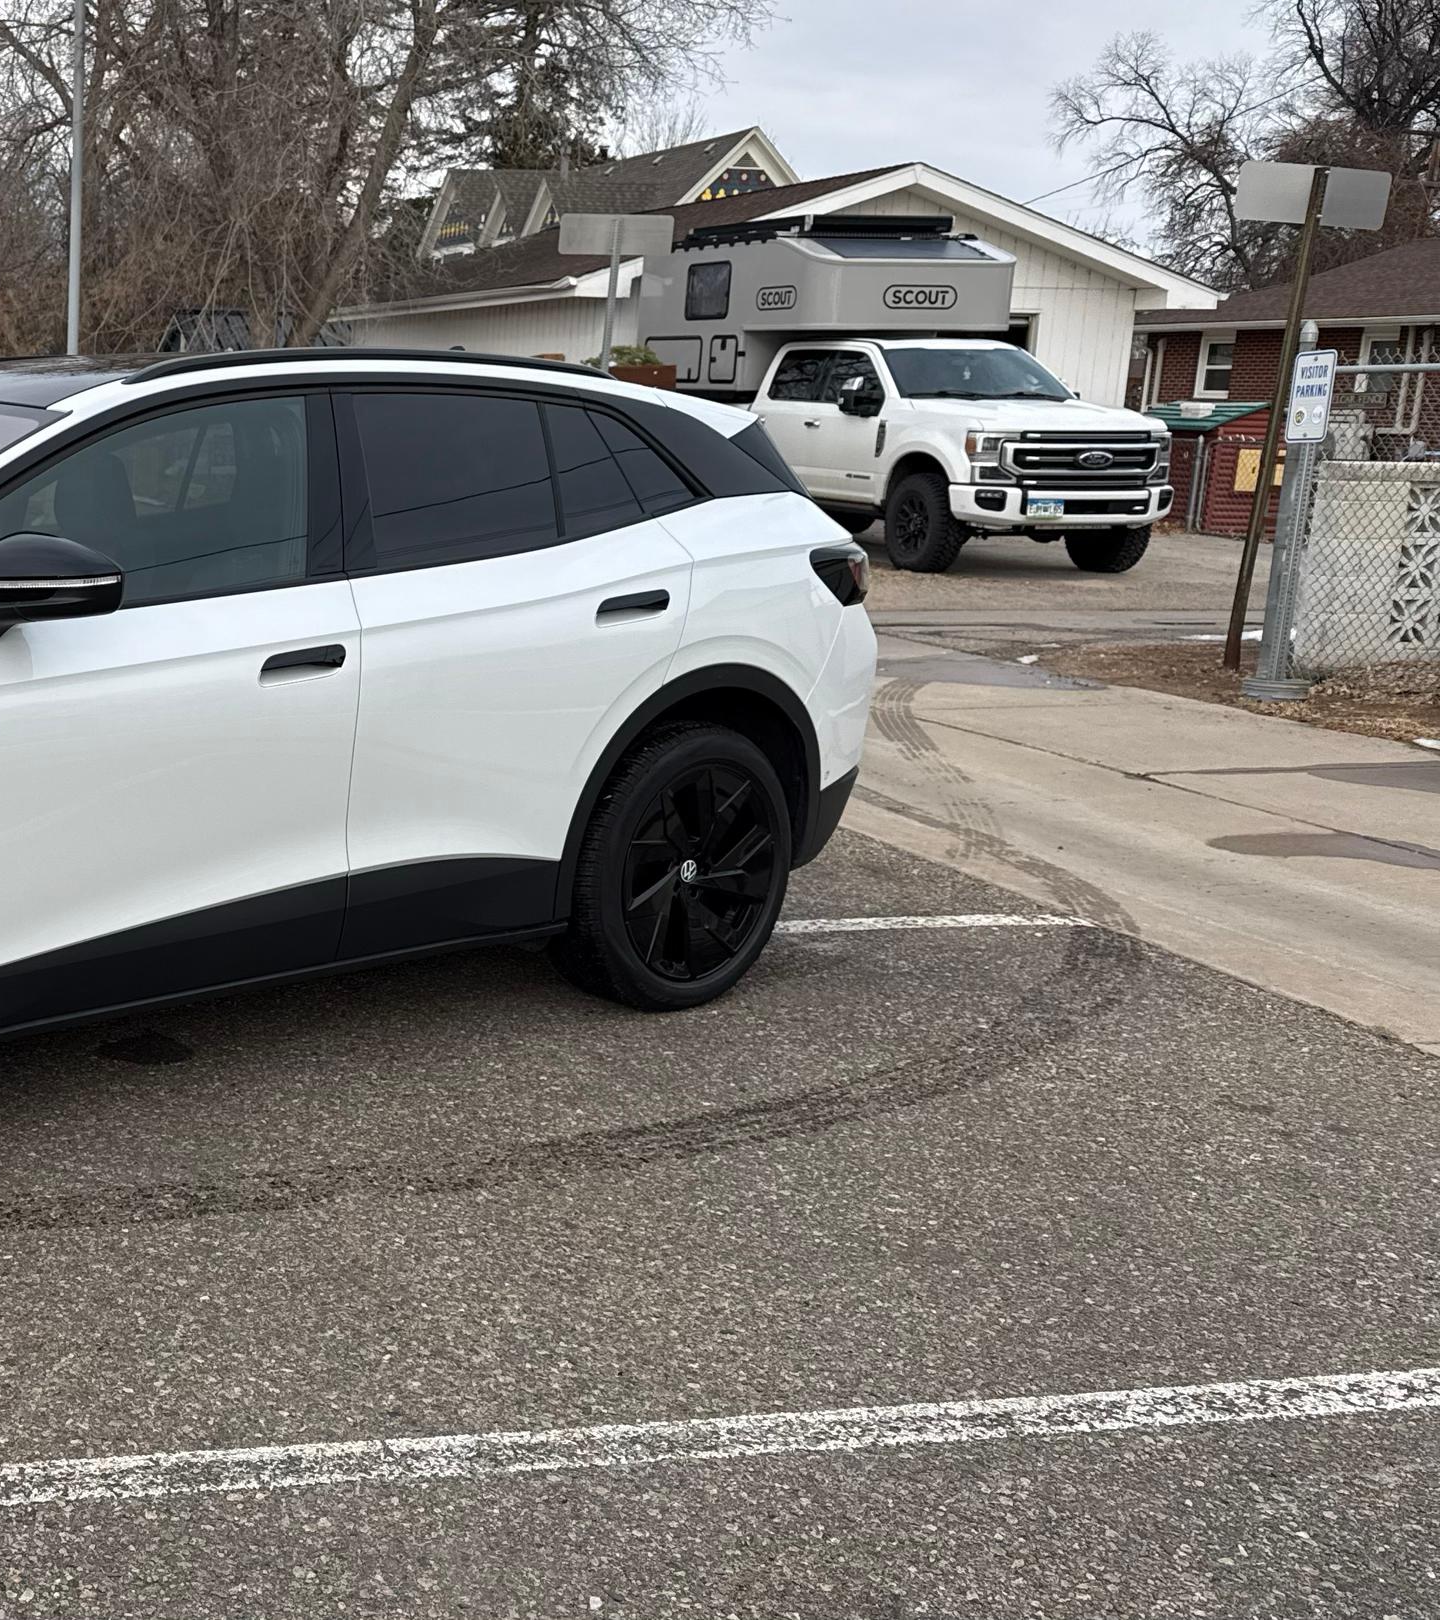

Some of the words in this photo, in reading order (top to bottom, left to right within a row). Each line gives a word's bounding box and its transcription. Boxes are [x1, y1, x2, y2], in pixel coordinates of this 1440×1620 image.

[760, 290, 792, 306] SCOUT
[891, 289, 949, 306] SCOUT
[1301, 365, 1328, 379] VISITOR
[1295, 383, 1328, 398] PARKING
